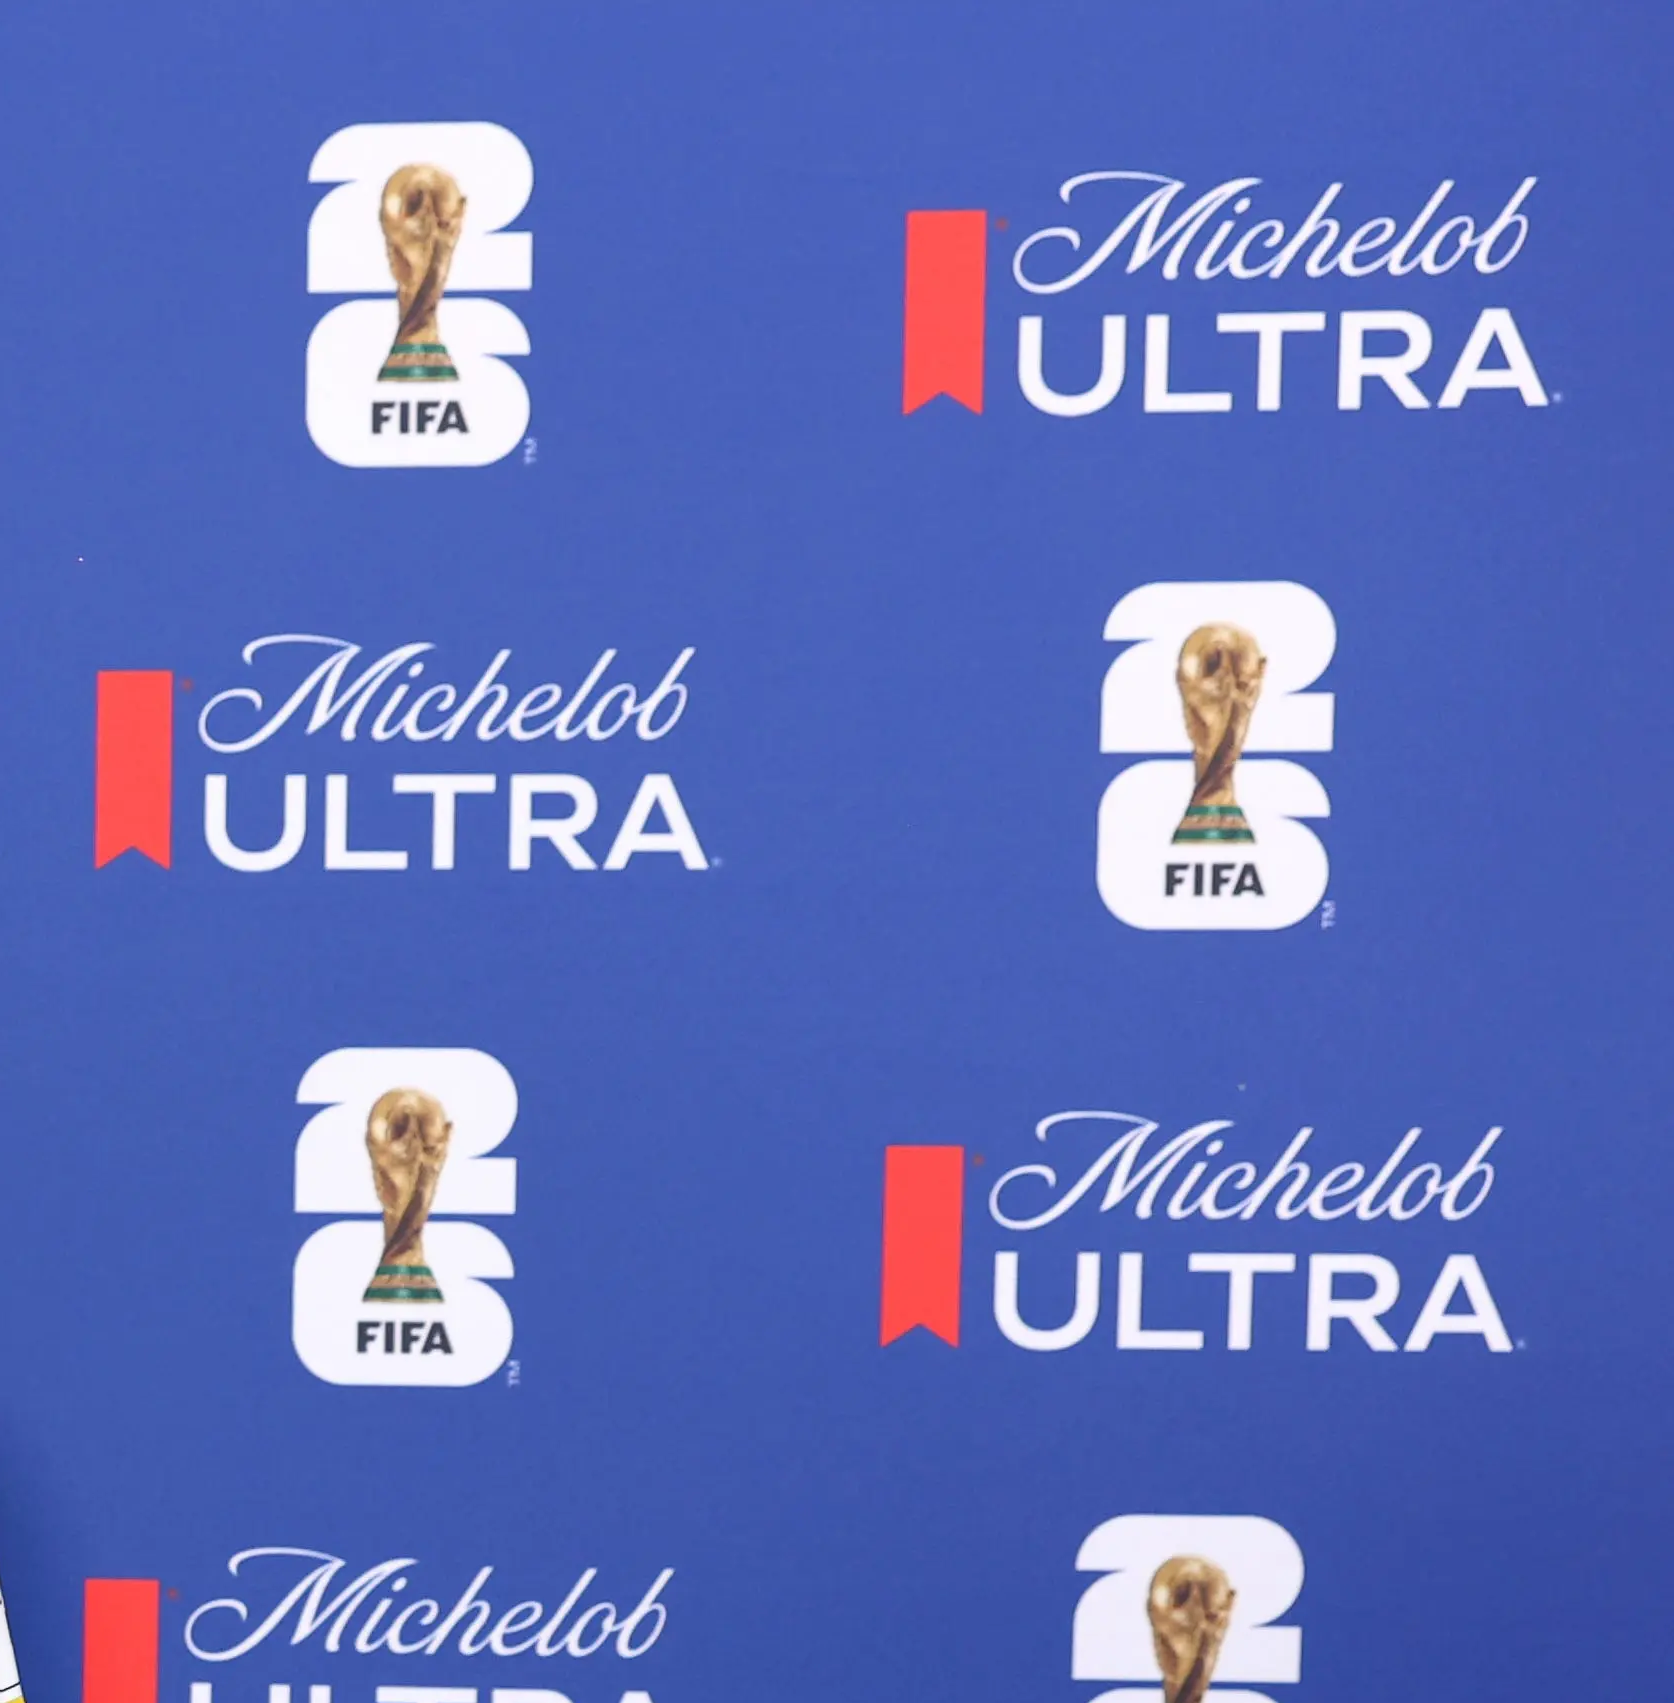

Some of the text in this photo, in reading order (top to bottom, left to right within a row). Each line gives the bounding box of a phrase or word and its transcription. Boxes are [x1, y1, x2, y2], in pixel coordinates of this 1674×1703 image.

[1012, 171, 1538, 295] Michelob
[1017, 307, 1549, 418] ULTRA
[372, 401, 468, 434] FIFA
[198, 634, 696, 753] Michelob
[204, 773, 709, 873] ULTRA
[1165, 864, 1264, 896] FIFA
[989, 1111, 1503, 1230] Michelob
[357, 1321, 452, 1354] FIFA
[993, 1251, 1513, 1353] ULTRA
[184, 1547, 674, 1661] Michelob
